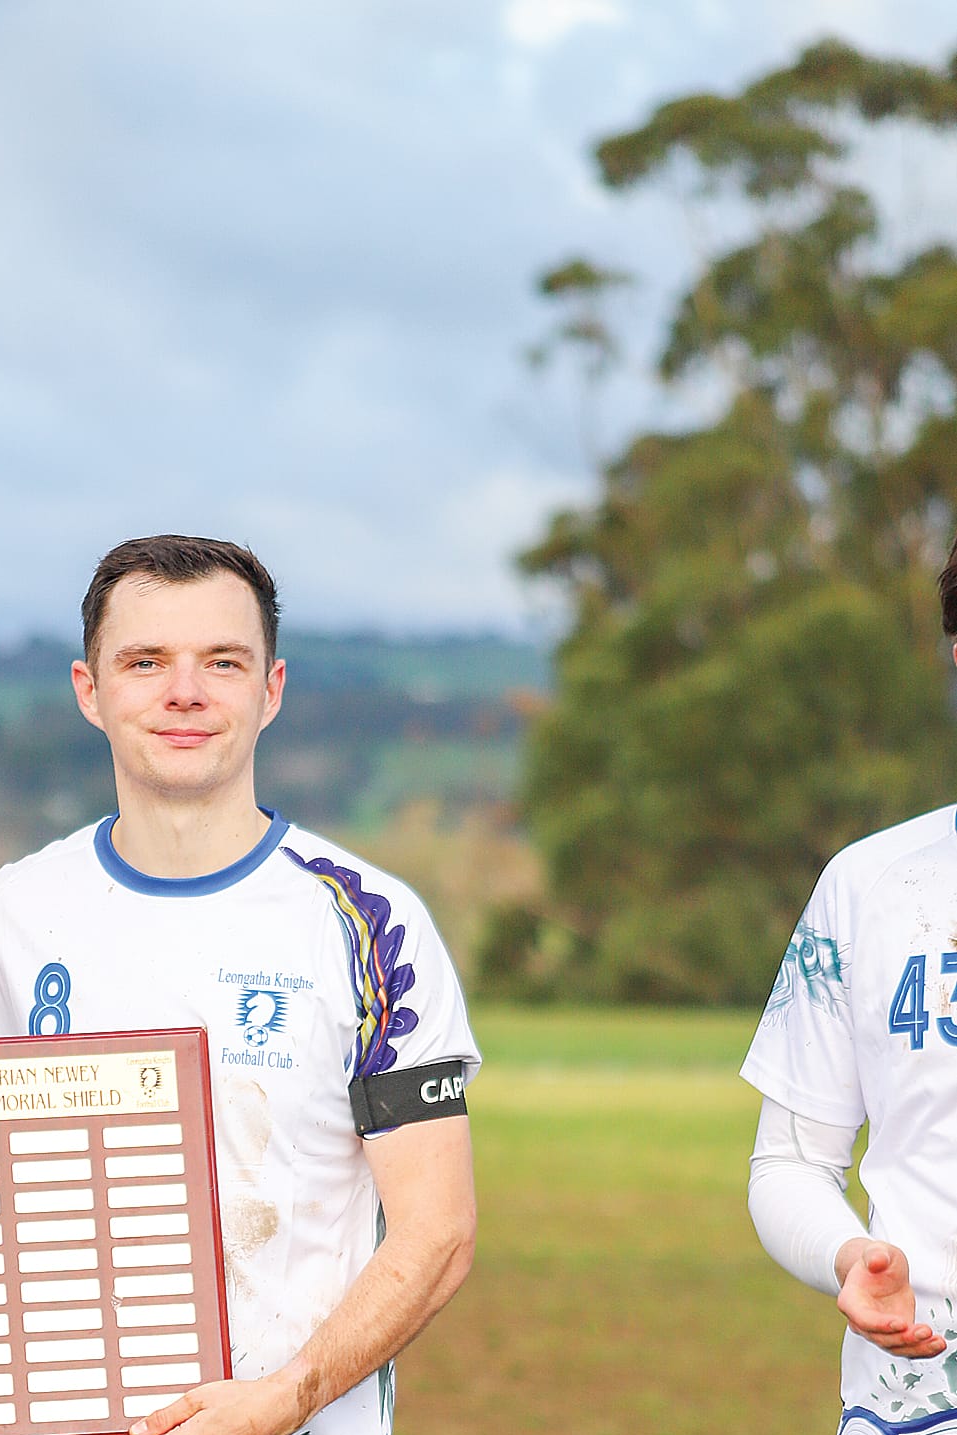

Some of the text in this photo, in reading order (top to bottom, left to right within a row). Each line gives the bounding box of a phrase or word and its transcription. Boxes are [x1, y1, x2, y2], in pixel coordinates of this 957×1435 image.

[218, 967, 315, 993] Leongatha Knights
[28, 962, 71, 1036] 8
[888, 952, 957, 1050] 43
[221, 1047, 293, 1070] Football Club
[44, 1064, 100, 1084] NEWEY
[62, 1089, 122, 1109] SHIELD
[420, 1077, 464, 1104] CAP
